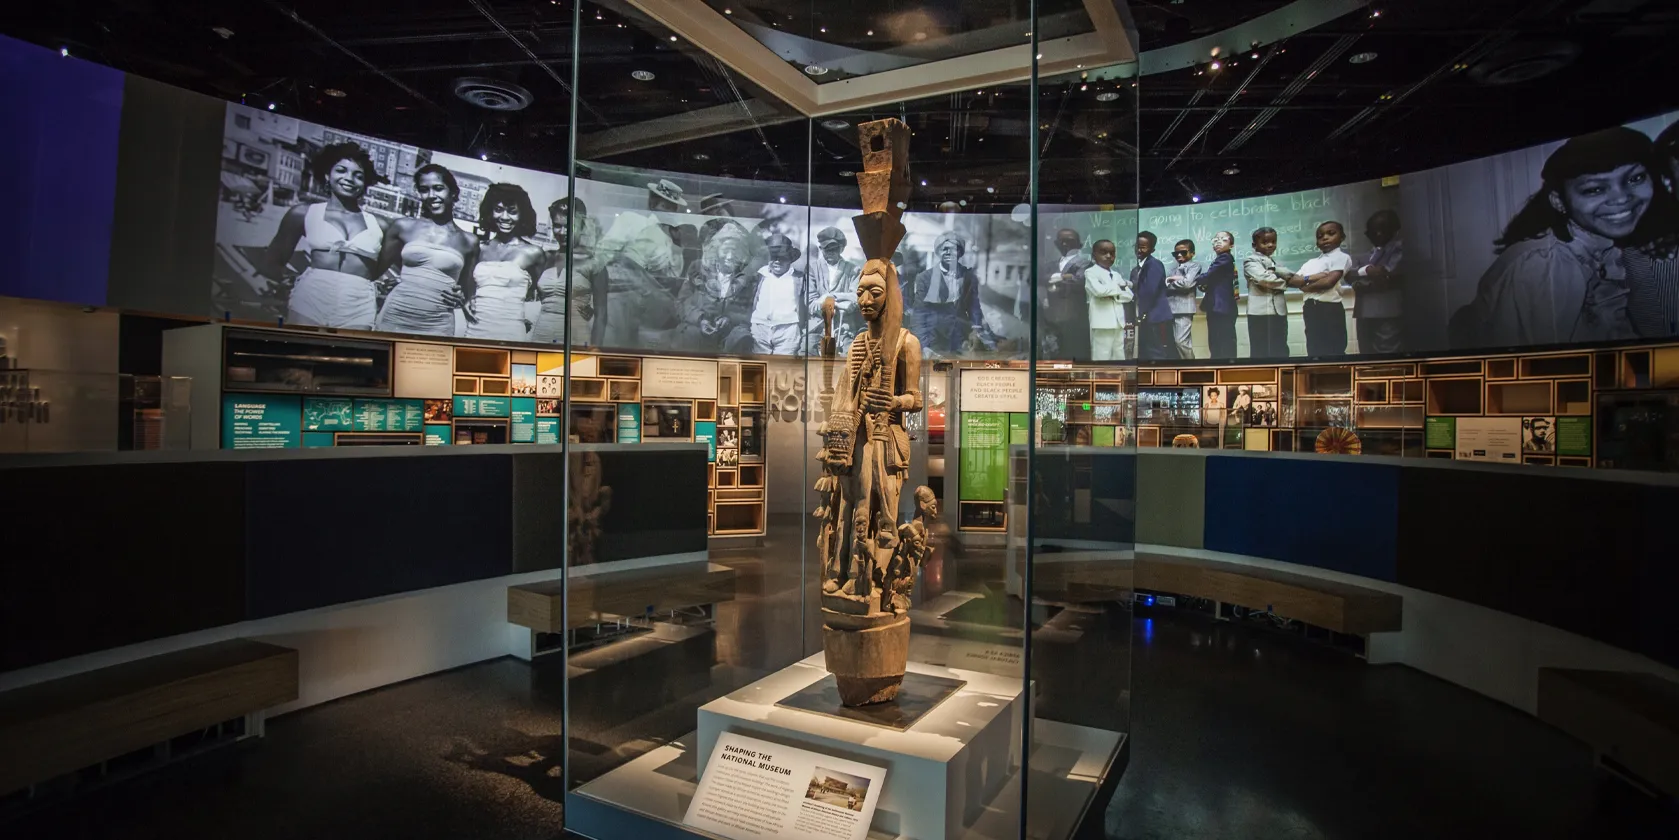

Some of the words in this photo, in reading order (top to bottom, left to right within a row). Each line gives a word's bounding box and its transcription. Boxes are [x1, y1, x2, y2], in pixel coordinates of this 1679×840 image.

[1089, 211, 1112, 228] We
[1150, 212, 1182, 230] going
[1190, 207, 1204, 220] to
[1209, 197, 1279, 220] celebrate
[1291, 190, 1331, 211] black
[1192, 225, 1212, 243] We
[724, 745, 756, 758] SHAPING
[758, 753, 772, 762] THE
[721, 753, 756, 767] NATIONAL
[758, 762, 792, 776] MUSEUM
